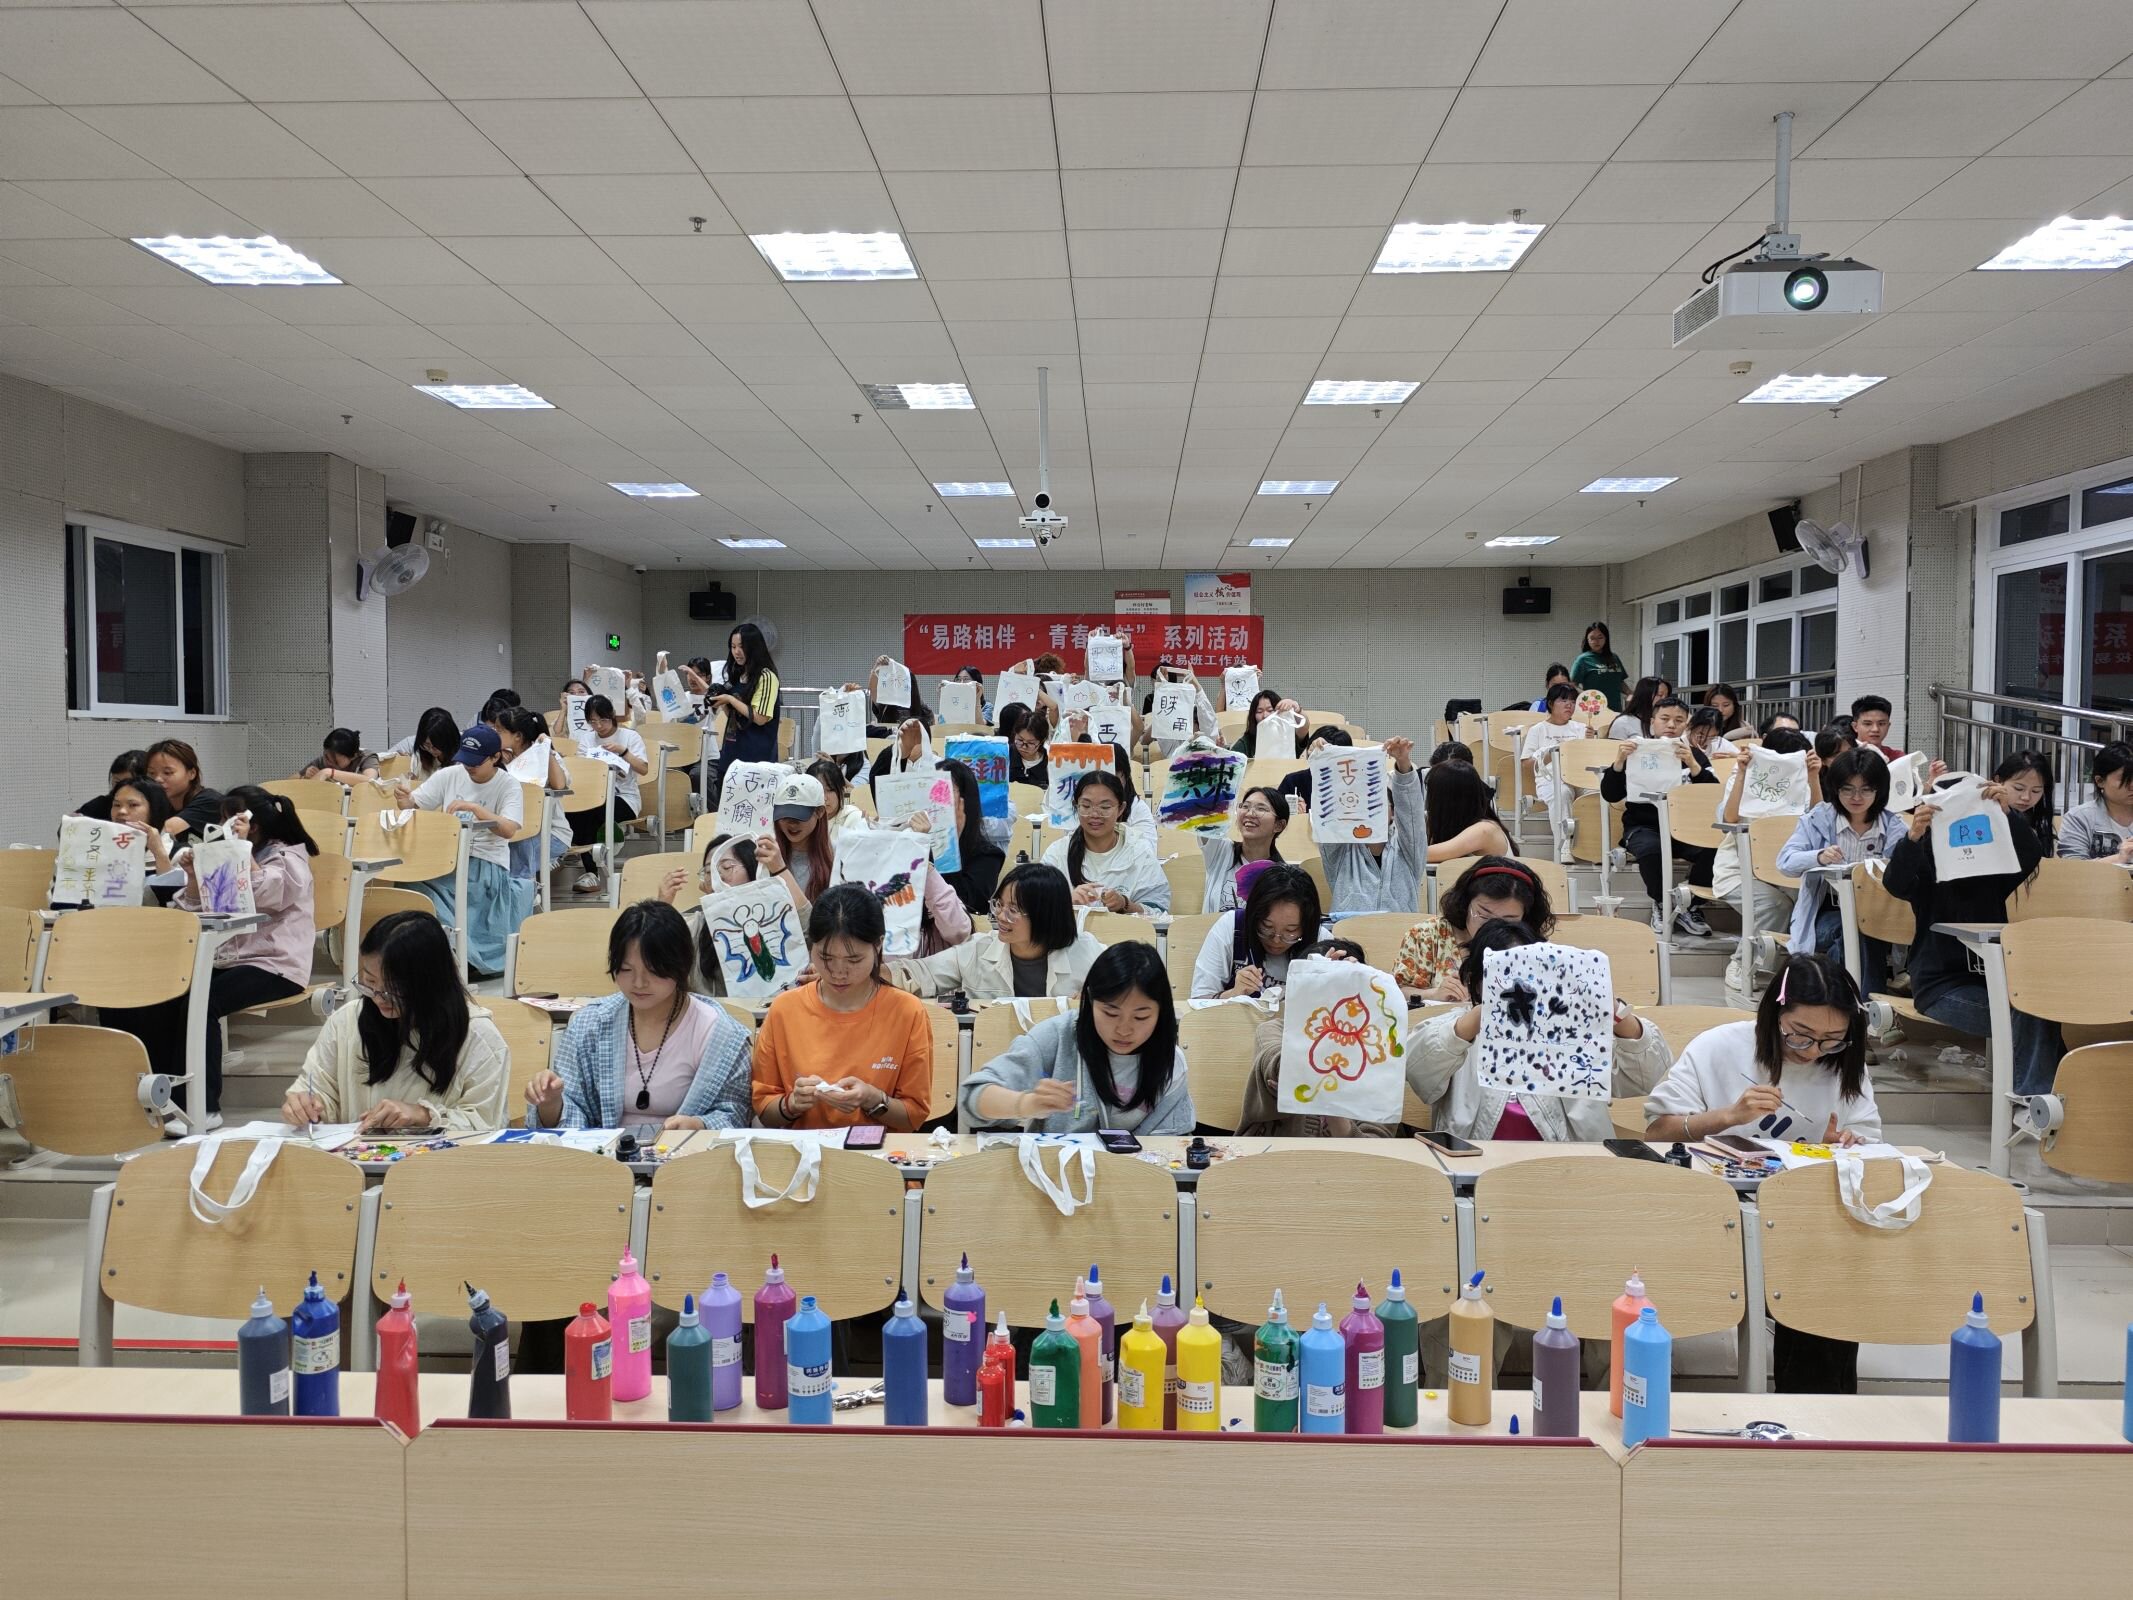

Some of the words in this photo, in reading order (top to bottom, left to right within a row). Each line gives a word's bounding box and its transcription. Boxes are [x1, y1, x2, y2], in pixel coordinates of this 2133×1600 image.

[1160, 654, 1248, 666] 校易班工作站
